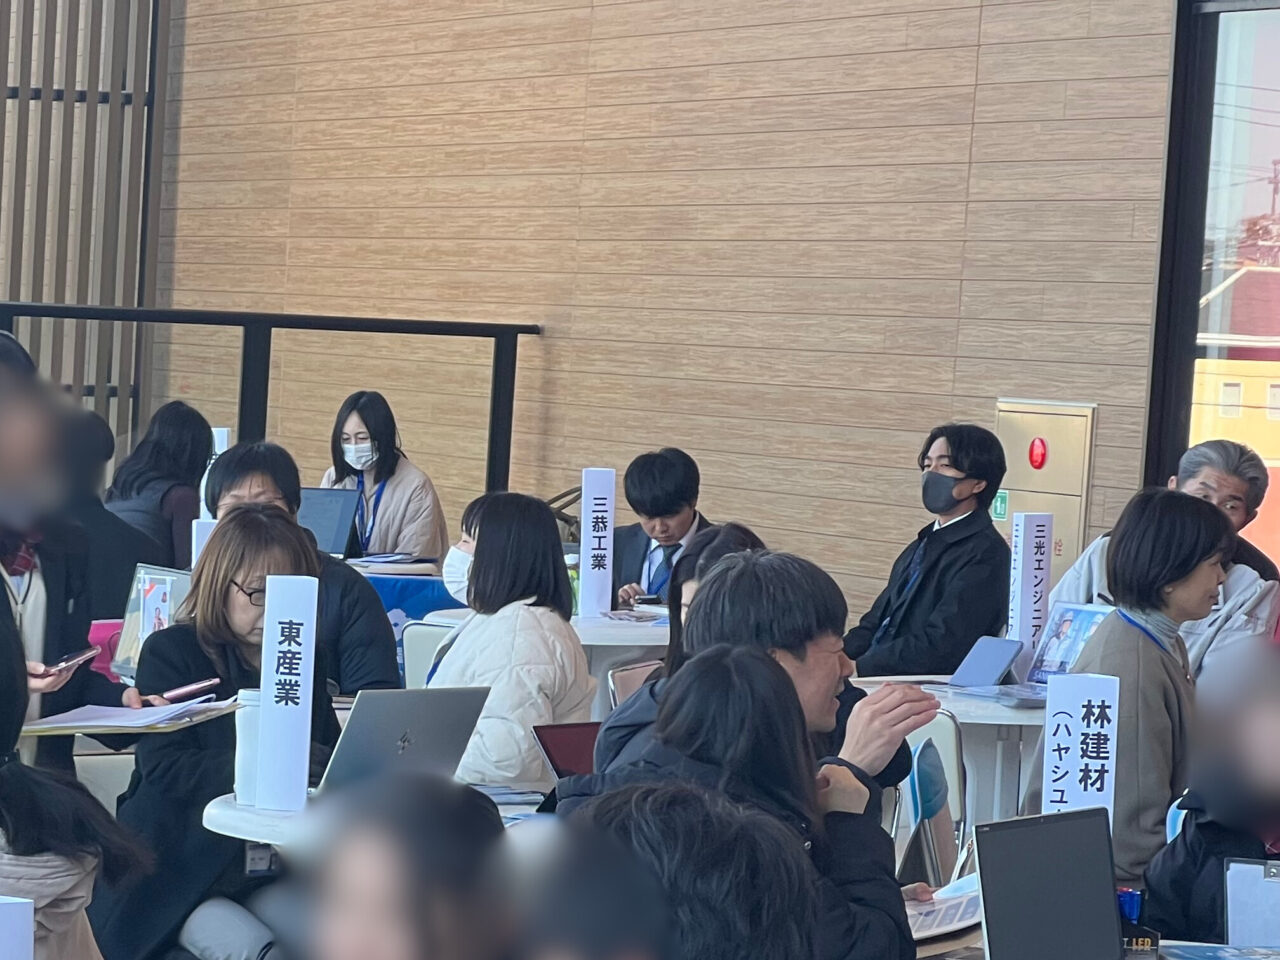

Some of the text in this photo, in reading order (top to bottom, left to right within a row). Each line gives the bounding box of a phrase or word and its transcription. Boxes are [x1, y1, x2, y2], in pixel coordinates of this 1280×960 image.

[591, 497, 608, 571] 三恭工業
[274, 619, 304, 706] 東産業
[1049, 711, 1073, 812] （ハヤシユ
[1079, 699, 1112, 793] 林建材
